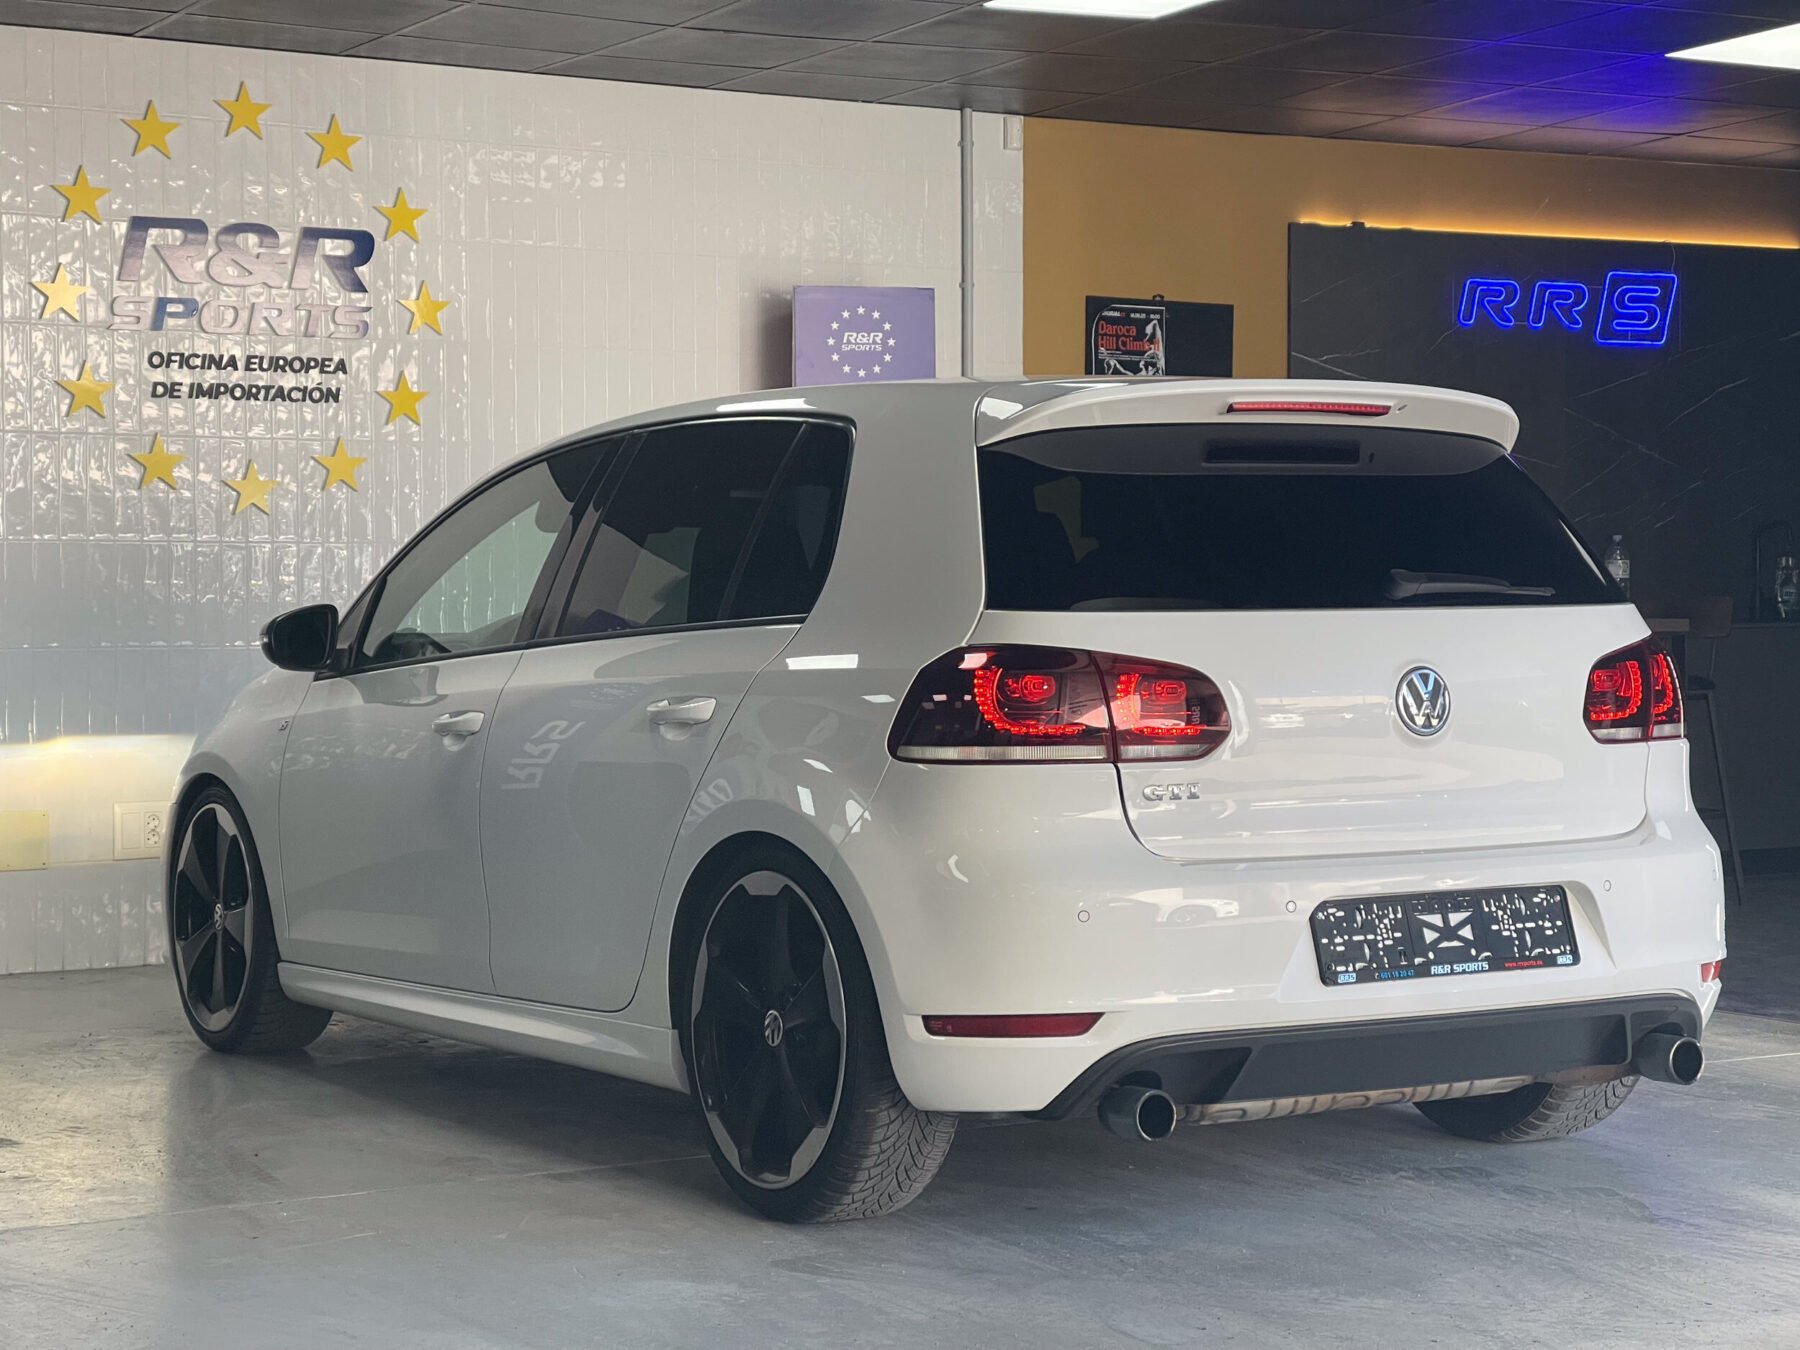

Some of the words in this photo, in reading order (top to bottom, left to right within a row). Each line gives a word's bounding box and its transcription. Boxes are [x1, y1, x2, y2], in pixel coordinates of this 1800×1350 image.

[117, 215, 376, 293] R&R
[107, 295, 373, 339] SPORTS
[843, 332, 883, 344] R&R
[1098, 320, 1137, 336] Daroca
[147, 351, 239, 371] OFICINA
[244, 355, 348, 375] EUROPEA
[151, 381, 183, 399] DE
[187, 382, 341, 403] IMPORTACIÓN
[1143, 783, 1200, 801] GTI
[1431, 964, 1451, 975] R&R
[1453, 961, 1489, 973] SPORTS
